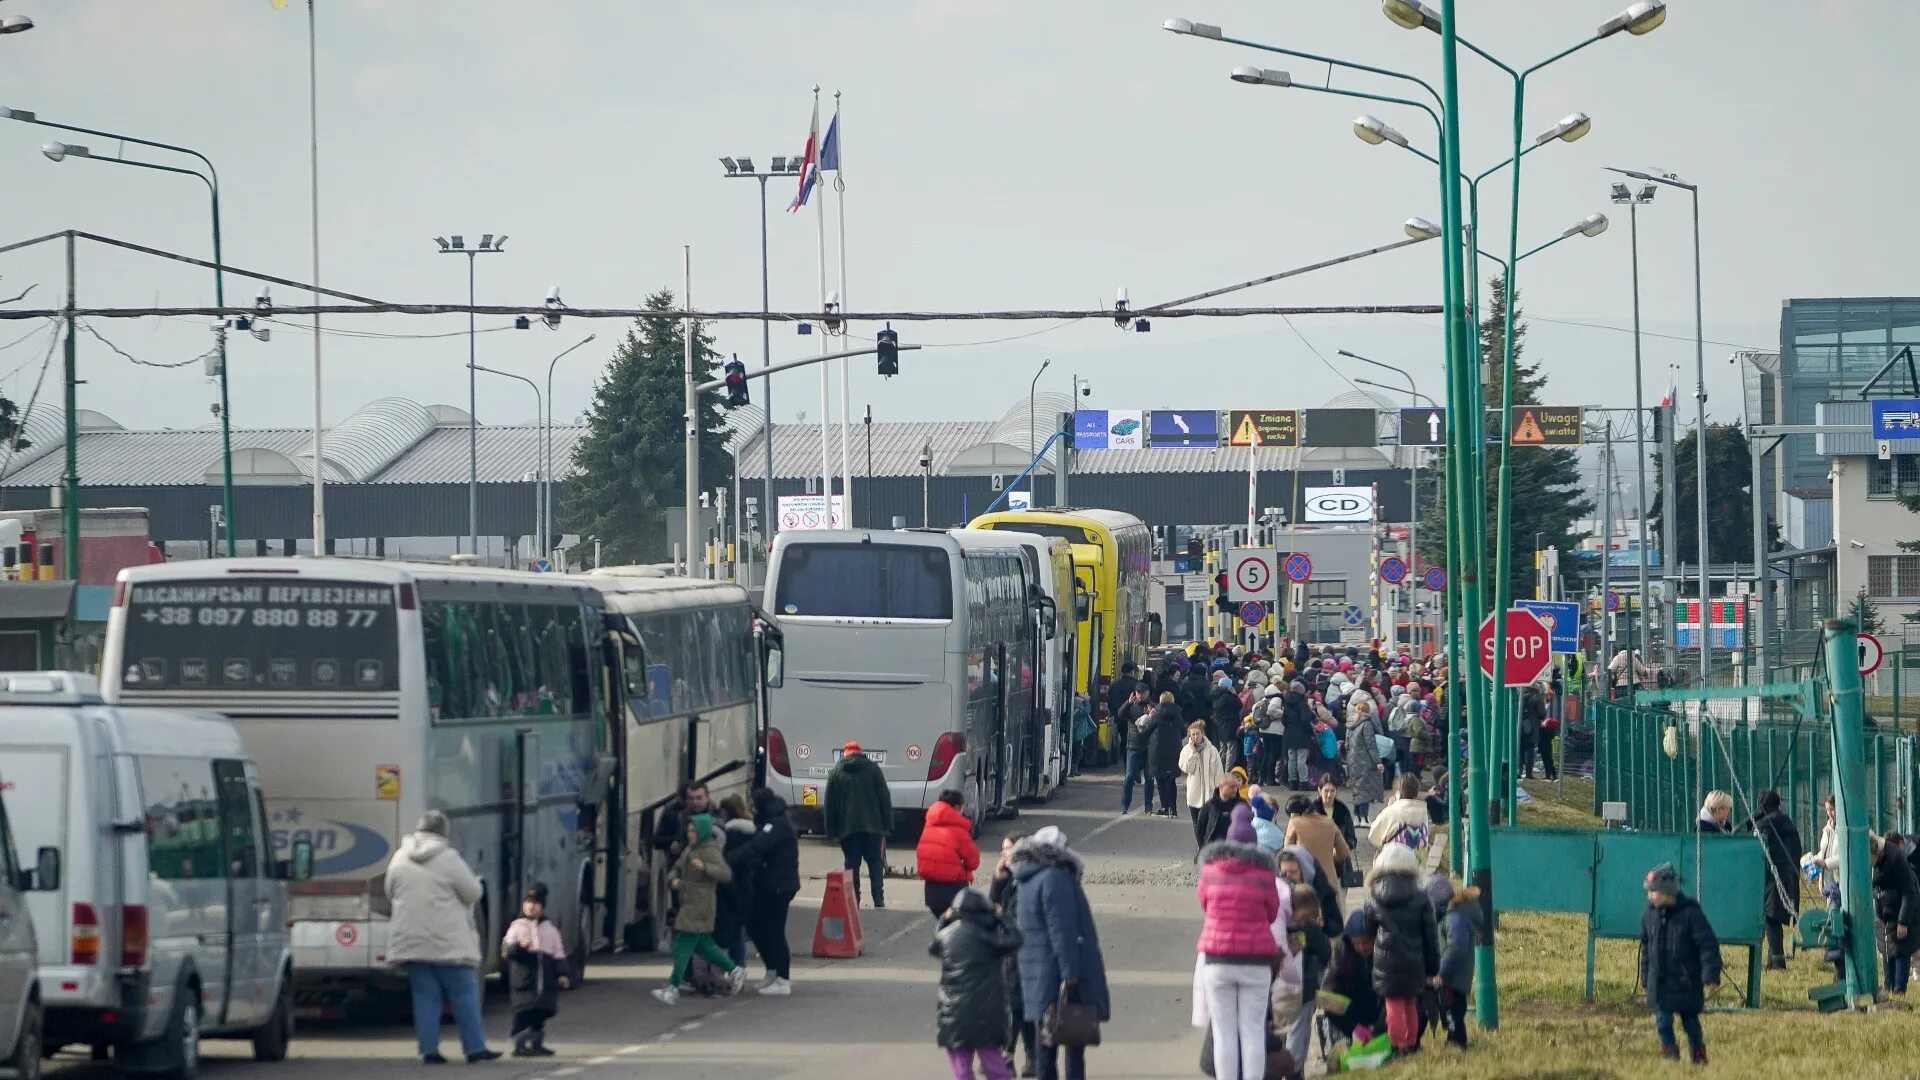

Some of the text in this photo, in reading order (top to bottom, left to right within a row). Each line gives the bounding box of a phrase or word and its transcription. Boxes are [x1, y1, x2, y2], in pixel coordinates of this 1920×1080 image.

[1259, 414, 1292, 423] Zmiana
[1540, 411, 1578, 425] Uwaga
[1115, 437, 1135, 445] CARS
[1881, 444, 1887, 455] 9
[994, 474, 1001, 489] 2
[1319, 499, 1359, 511] CD
[1248, 566, 1259, 584] 5
[141, 607, 379, 628] +38 097 880 88 77
[908, 749, 920, 757] 100
